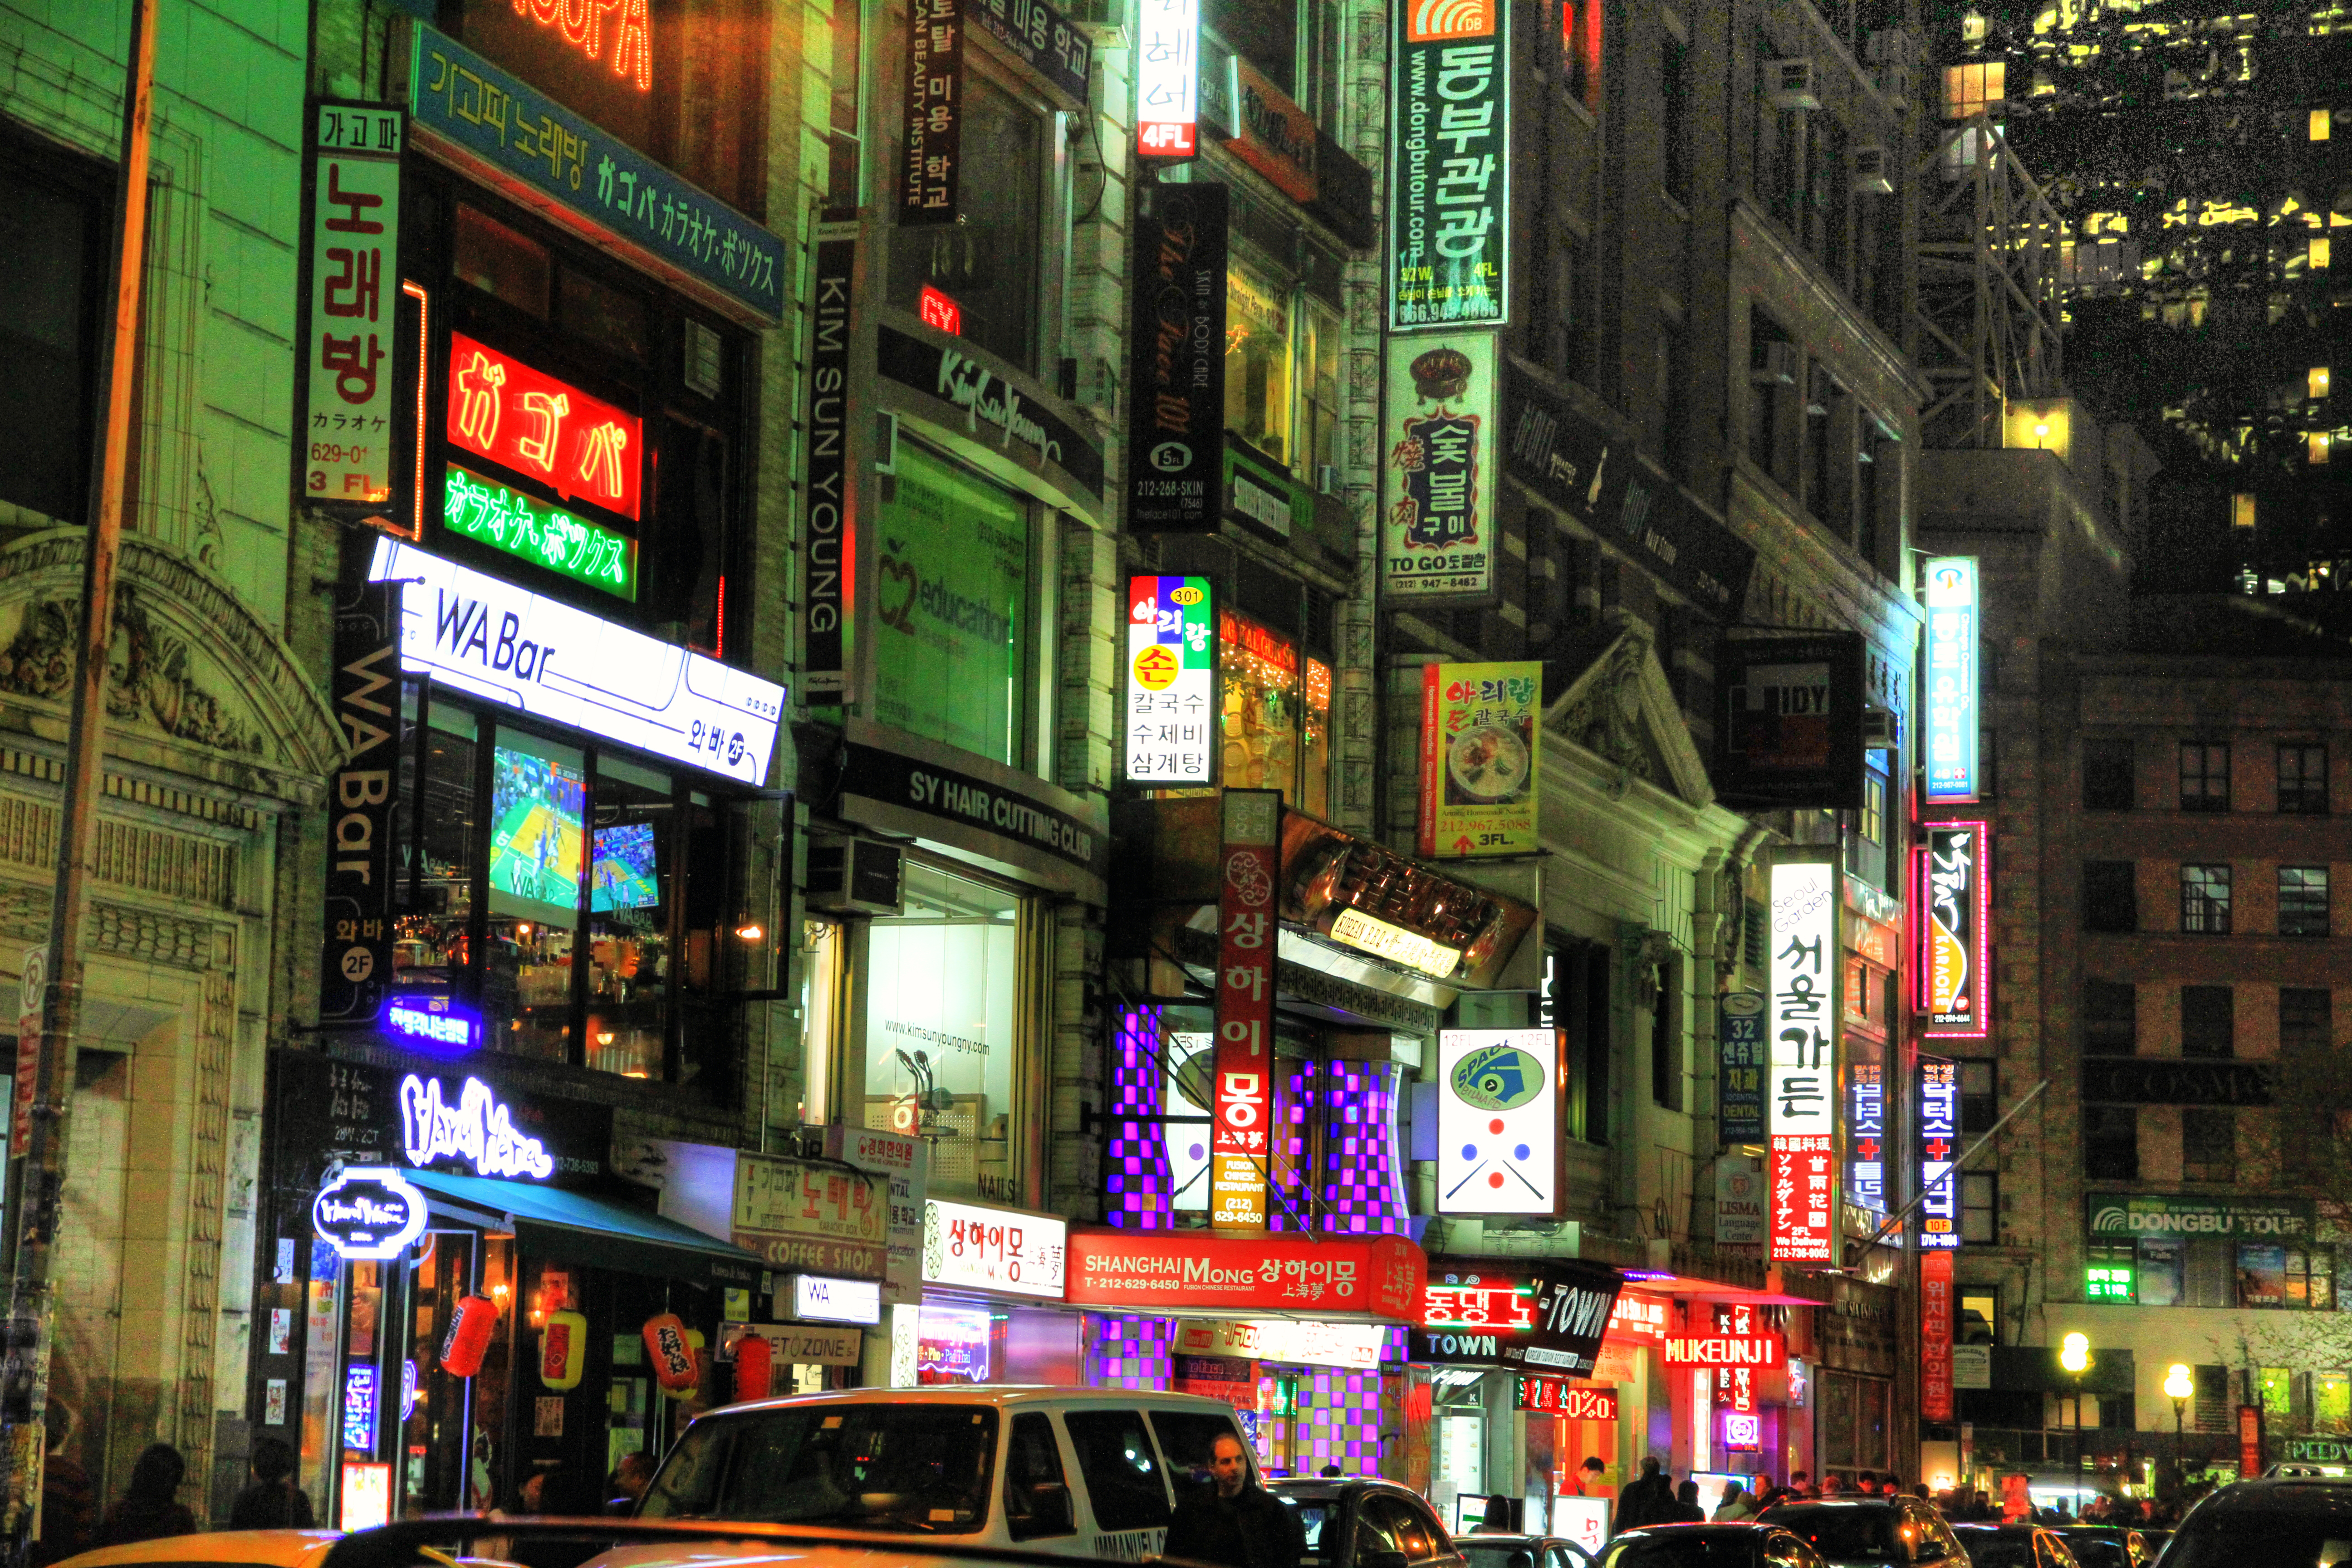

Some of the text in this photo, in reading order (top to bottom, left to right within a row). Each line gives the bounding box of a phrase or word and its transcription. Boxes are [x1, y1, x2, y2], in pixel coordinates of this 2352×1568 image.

[1465, 18, 1483, 31] DB
[430, 50, 589, 191] 가고파 노래방
[908, 39, 927, 206] BEAUTY INSTITUTE
[324, 112, 397, 152] 가고파
[1142, 123, 1191, 149] 4FL
[1405, 49, 1431, 258] www.dongbutour.com
[1436, 44, 1496, 259] 동부관광
[321, 162, 387, 405] 노래방
[1192, 269, 1210, 389] SKIN BODY CARE
[312, 412, 387, 432] カラオケ
[457, 352, 627, 498] ガゴパ
[810, 277, 846, 634] KIM SUN YOUNG
[308, 470, 391, 495] 3 FL
[1137, 480, 1204, 496] 212-268-SKIN
[1422, 423, 1470, 537] 숯불 구이
[1181, 497, 1203, 509] (7546)
[1389, 555, 1446, 573] TO GO
[1395, 579, 1416, 589] (212)
[1174, 590, 1199, 603] 301
[1132, 597, 1211, 652] 아리랑
[1137, 647, 1175, 684] 손
[1446, 676, 1535, 706] 아리랑
[1133, 693, 1205, 715] 칼국수
[1426, 685, 1436, 726] Homemade
[1475, 707, 1530, 726] 칼국수
[688, 719, 745, 762] 와바 2F
[1132, 724, 1203, 745] 수제비
[1132, 752, 1204, 774] 삼계탕
[910, 771, 1091, 858] SY HAIR CUTTING CLUB
[1424, 788, 1434, 819] Chicken
[1439, 818, 1532, 833] 212.967.5088
[1478, 833, 1514, 846] 3FL.
[1773, 877, 1819, 914] Seoul
[1773, 889, 1833, 933] Garden
[336, 919, 384, 942] 와바
[1335, 915, 1367, 940] KOREAN
[346, 956, 370, 973] 2F
[1934, 935, 1950, 1007] KARAOKE
[1221, 912, 1270, 1128] 상하이몽
[1731, 1019, 1755, 1039] 32
[1776, 934, 1830, 1118] 서울가든
[884, 1018, 991, 1057] www.kimsunyoungny.com
[1443, 1034, 1475, 1047] 12FL
[1519, 1033, 1551, 1046] 12FL
[1922, 1063, 1955, 1074] 학생
[1923, 1073, 1955, 1083] 전문
[1922, 1083, 1957, 1138] 닥터스
[867, 1137, 913, 1162] 경희한의원
[1216, 1131, 1264, 1148] 上海夢
[553, 1156, 599, 1174] 12-736-6393
[1223, 1171, 1256, 1181] CHINESE
[1225, 1160, 1255, 1171] FUSION
[977, 1172, 1016, 1203] NAILS
[1215, 1181, 1264, 1193] RESTAURANT
[1225, 1198, 1253, 1212] (212)
[1718, 1201, 1761, 1216] LISMA
[1214, 1211, 1263, 1224] 629-6450
[1718, 1216, 1761, 1231] Language
[1930, 1220, 1948, 1231] 10 F
[2128, 1213, 2233, 1234] DONGBU
[892, 1226, 916, 1237] INSTITUTE
[1725, 1230, 1754, 1241] Center
[1775, 1235, 1828, 1248] We Delivery
[1791, 1226, 1812, 1237] 2FL
[767, 1241, 874, 1271] COFFEE SHOP
[946, 1219, 1024, 1283] 상하이몽
[1773, 1247, 1830, 1259] 212-736-9002
[1085, 1254, 1254, 1285] SHANGHAI MONG
[1257, 1257, 1357, 1298] 상하이몽
[807, 1281, 830, 1305] WA
[1202, 1284, 1224, 1292] CHINESE
[1223, 1284, 1256, 1293] RESTAURANT
[1281, 1282, 1325, 1301] 上海夢
[802, 1338, 845, 1358] ZONE
[927, 1347, 971, 1363] Pho Pad Thai
[1426, 1333, 1497, 1357] TOWN
[1665, 1338, 1773, 1364] MUKEUNJI
[1468, 1393, 1477, 1402] K
